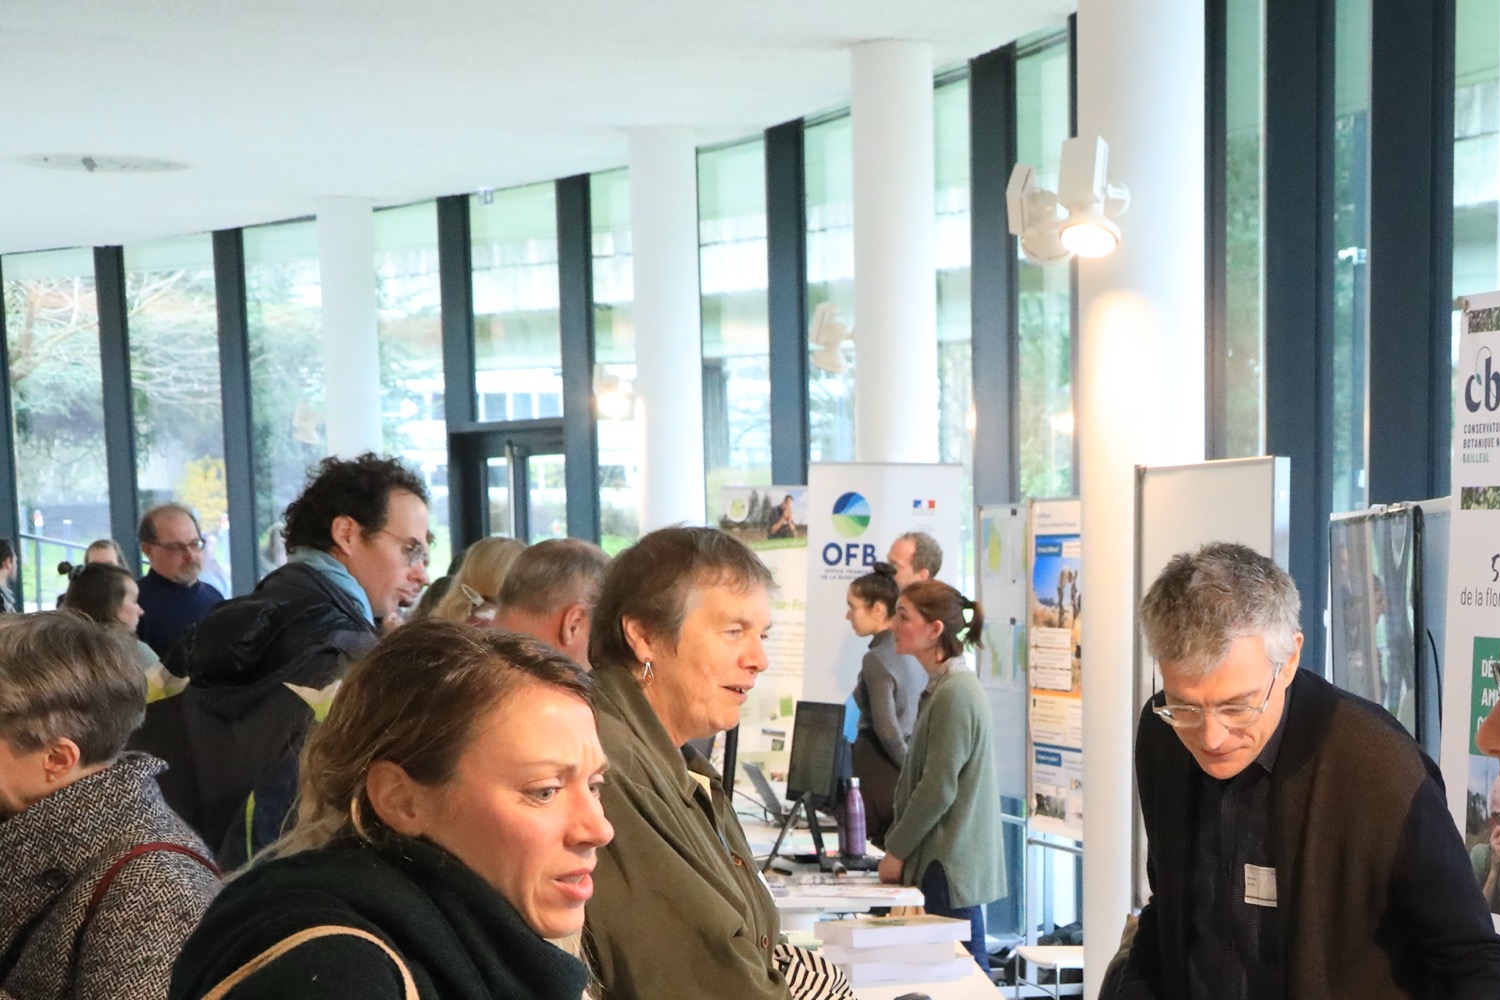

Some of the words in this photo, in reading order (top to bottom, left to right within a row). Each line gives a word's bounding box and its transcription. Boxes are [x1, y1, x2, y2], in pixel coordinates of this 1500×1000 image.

[1462, 437, 1494, 449] BOTANIQUE
[1462, 452, 1490, 464] BAILLEUL
[822, 542, 877, 567] OFB
[1491, 554, 1500, 582] 5
[1460, 588, 1472, 606] de
[1474, 587, 1482, 606] la
